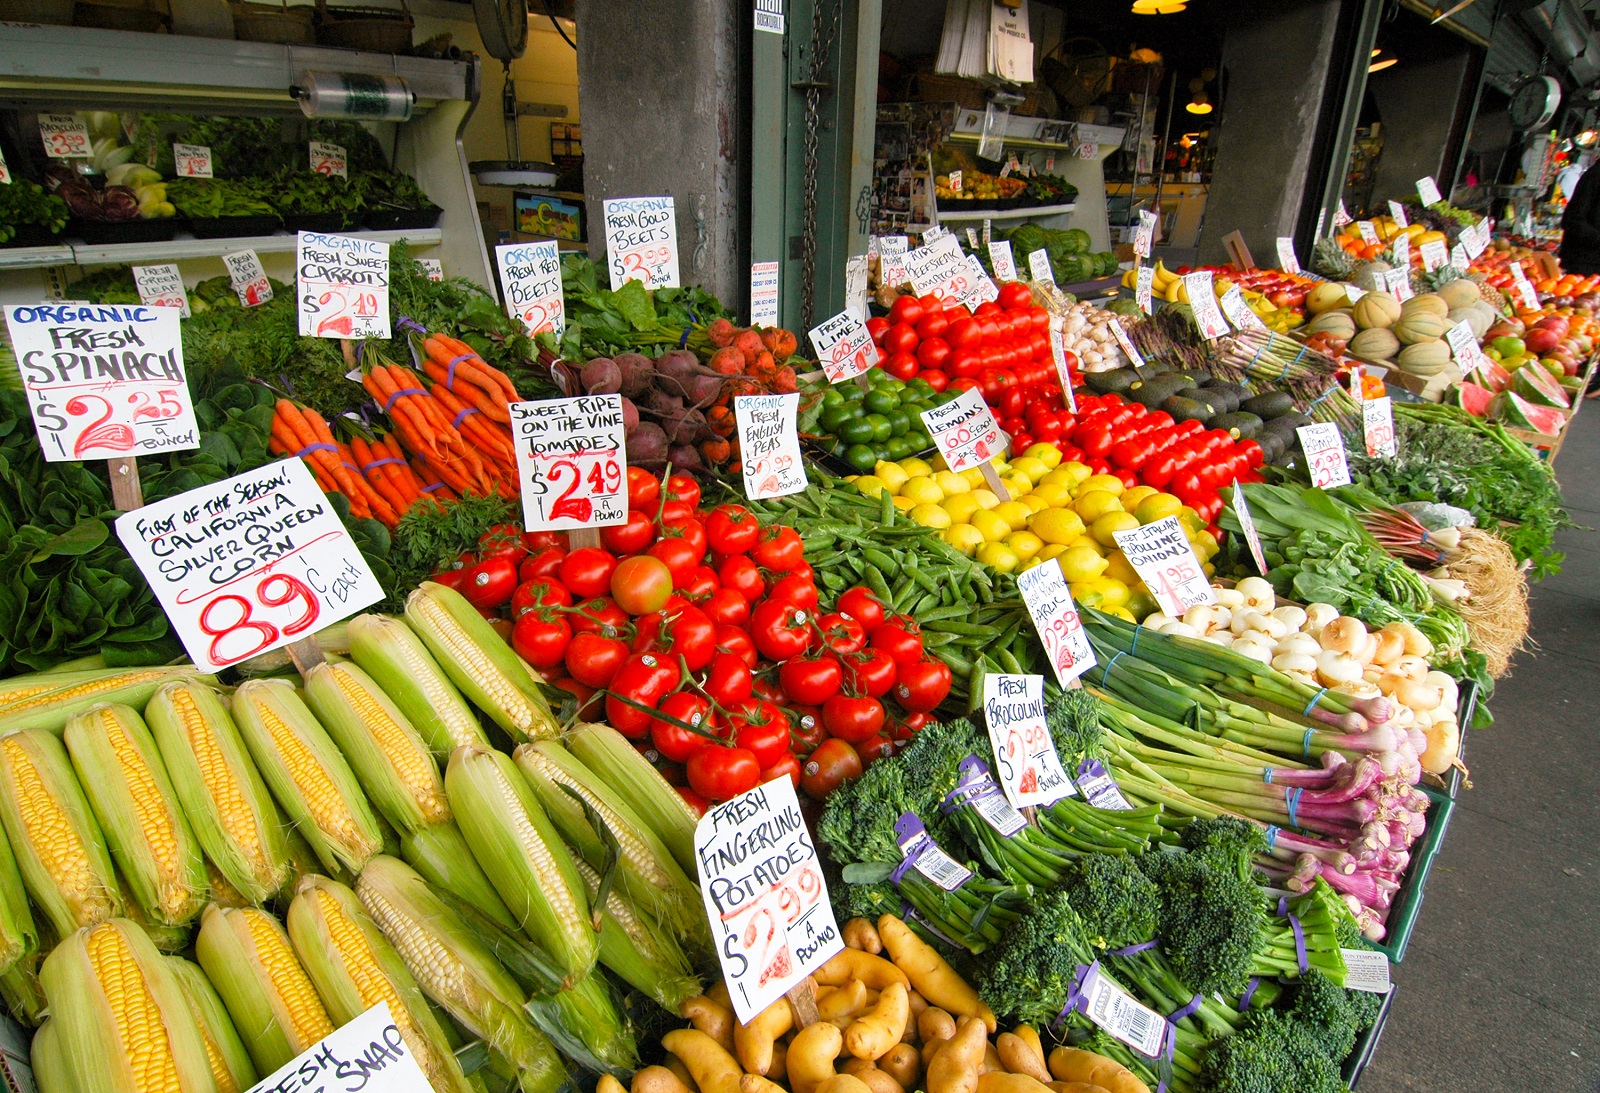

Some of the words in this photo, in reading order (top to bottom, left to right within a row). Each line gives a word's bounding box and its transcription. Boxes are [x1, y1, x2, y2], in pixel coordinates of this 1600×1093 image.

[607, 214, 637, 228] FRESH
[639, 210, 670, 228] GOLD
[302, 233, 382, 254] ORGANIC
[609, 226, 669, 250] BEETS
[228, 252, 253, 267] FRESH
[302, 246, 341, 266] FRESH
[345, 252, 389, 270] SWEET
[905, 248, 960, 278] BEEFSTEAK
[908, 245, 940, 261] RIPE
[143, 266, 172, 276] FRESH
[233, 263, 256, 274] RED
[236, 270, 258, 284] LEAF
[300, 264, 388, 287] CARROTS
[506, 263, 536, 280] FRESH
[539, 258, 558, 274] RED
[651, 272, 671, 284] BUNCH
[914, 262, 968, 290] TOMATOES
[138, 274, 179, 286] GREEN
[145, 285, 178, 296] LEAF
[507, 278, 559, 304] BEETS
[14, 306, 158, 324] ORGANIC
[818, 314, 850, 336] FRESH
[48, 325, 146, 352] FRESH
[352, 328, 384, 337] BUNCH
[818, 319, 862, 350] LIMES
[23, 348, 184, 383] SPINACH
[511, 403, 568, 419] SWEET
[573, 396, 620, 414] RIPE
[738, 396, 784, 410] ORGANIC
[928, 401, 960, 420] FRESH
[522, 420, 548, 434] ON
[552, 416, 584, 432] THE
[587, 412, 623, 428] VINE
[750, 409, 779, 424] FRESH
[928, 404, 983, 434] LEMONS
[134, 430, 194, 449] BUNCH
[746, 417, 784, 443] ENGLISH
[1306, 424, 1331, 437] FRESH
[522, 434, 620, 455] TOMATOES
[753, 436, 780, 456] PEAS
[1304, 434, 1340, 452] RAMPS
[778, 478, 802, 490] POUND
[136, 513, 176, 541] FIRST
[184, 506, 200, 524] OF
[204, 494, 231, 516] THE
[234, 466, 292, 504] SEASON!
[602, 500, 610, 510] A
[151, 492, 296, 557] CALIFORNIA
[594, 510, 624, 522] POUND
[1138, 518, 1178, 540] ITALIAN
[158, 540, 242, 582] SILVER
[244, 504, 324, 545] QUEEN
[1131, 542, 1190, 566] ONIONS
[208, 535, 296, 584] CORN
[332, 558, 362, 603] EACH
[1040, 576, 1066, 599] YOUNG
[1181, 592, 1208, 608] POUND
[998, 676, 1028, 698] FRESH
[986, 698, 1042, 729] BROCCOLINI
[1038, 769, 1066, 792] BUNCH
[711, 787, 770, 833] FRESH
[699, 806, 802, 879] FINGERLING
[709, 832, 814, 914] POTATOES
[806, 920, 815, 939] A
[796, 925, 836, 965] POUND
[336, 1024, 404, 1092] SNAP
